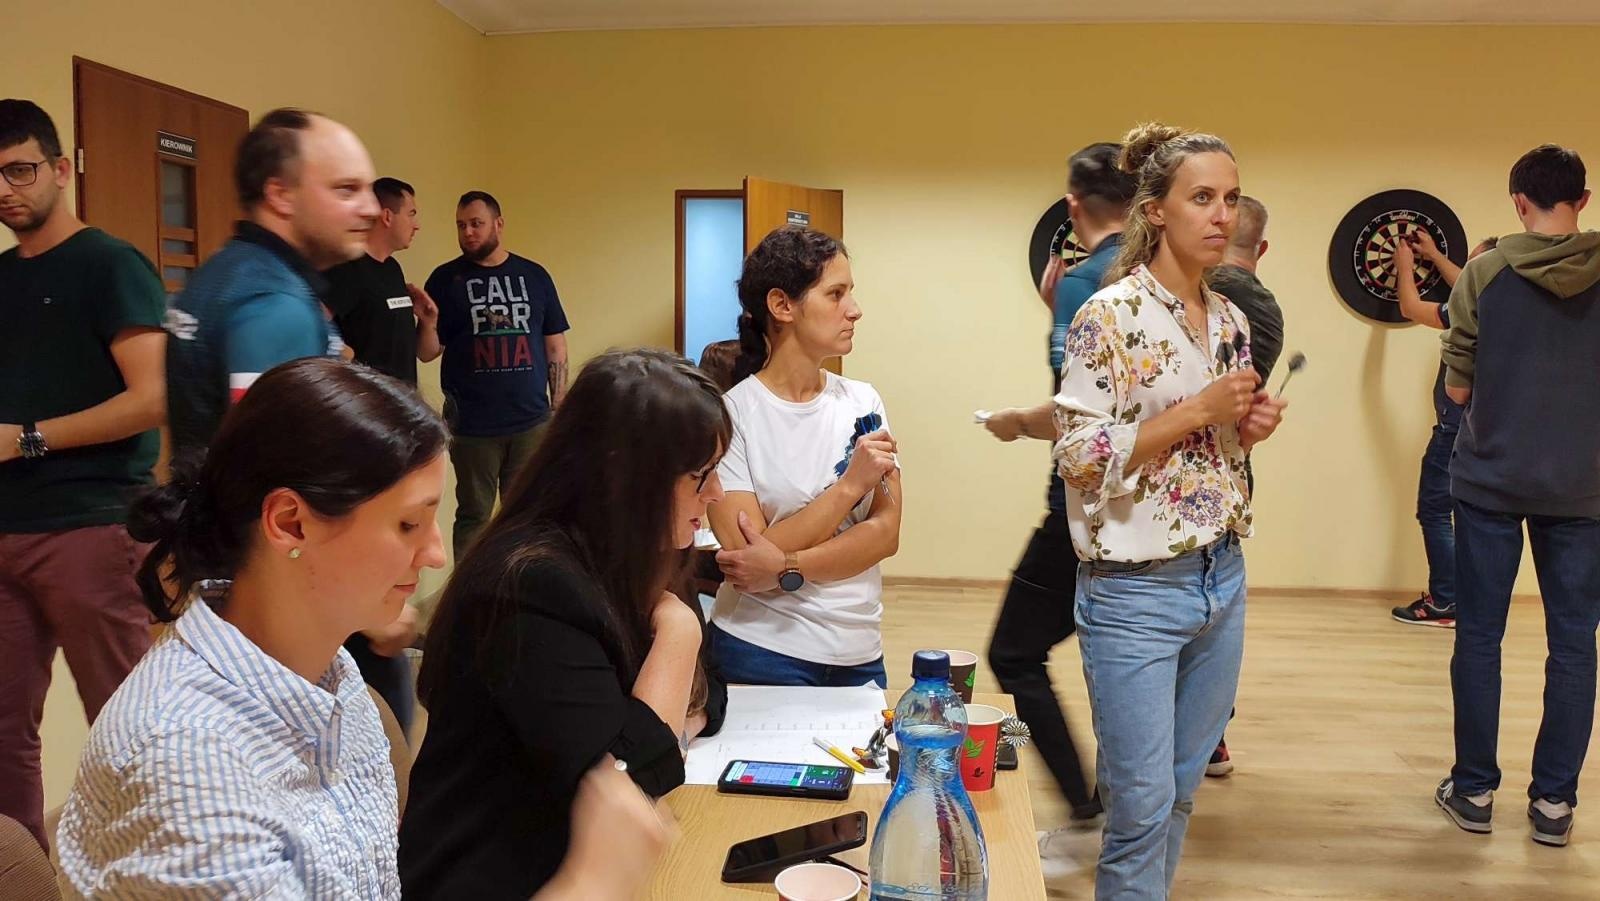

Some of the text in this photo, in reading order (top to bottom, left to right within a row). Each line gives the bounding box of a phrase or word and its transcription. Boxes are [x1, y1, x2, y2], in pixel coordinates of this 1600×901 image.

[160, 138, 193, 152] KIEROWNIK
[466, 275, 529, 304] CALI
[474, 336, 532, 368] NIA
